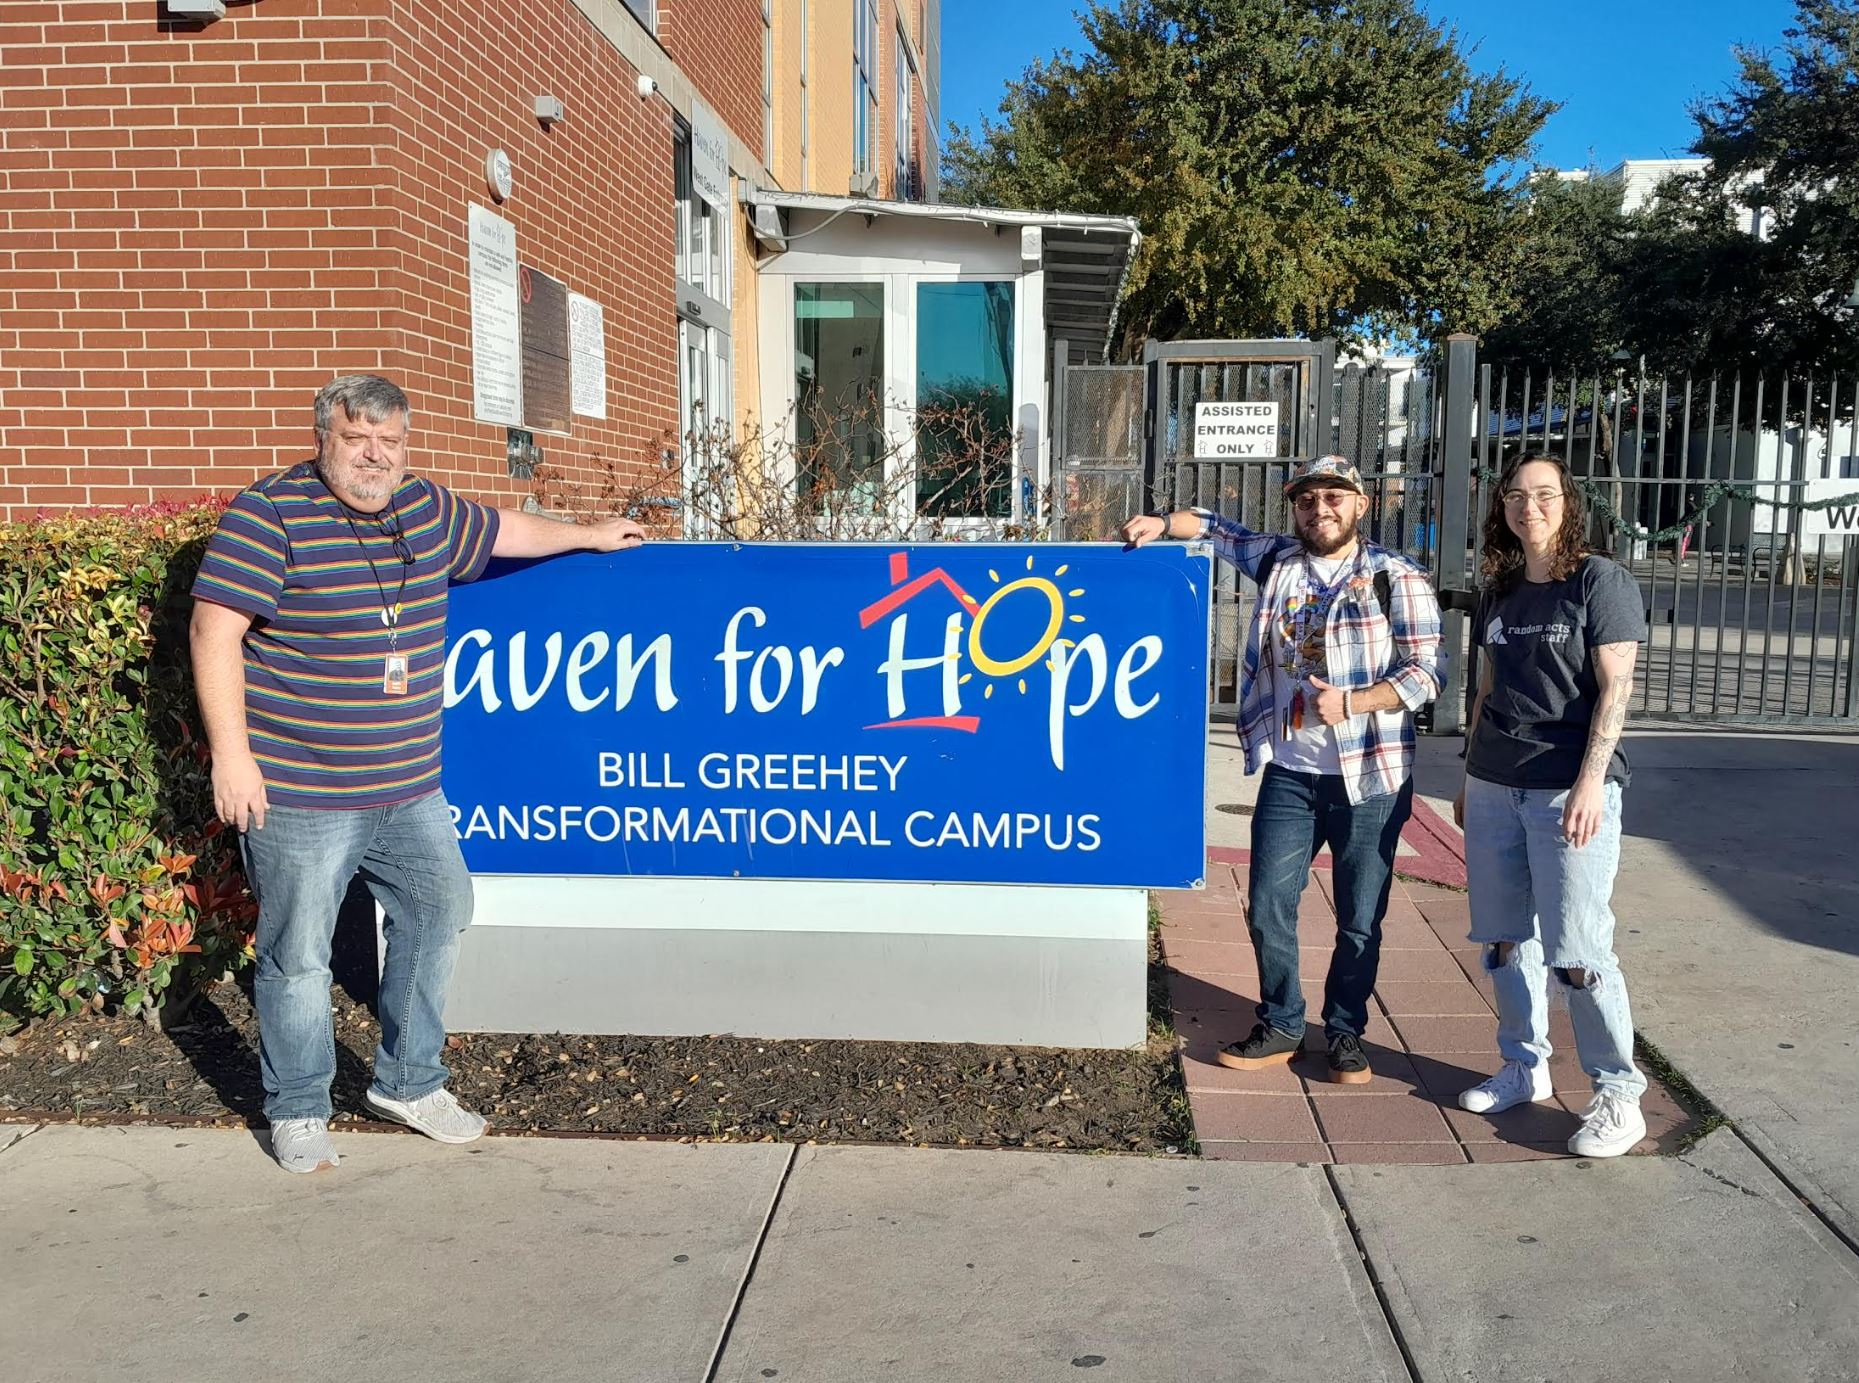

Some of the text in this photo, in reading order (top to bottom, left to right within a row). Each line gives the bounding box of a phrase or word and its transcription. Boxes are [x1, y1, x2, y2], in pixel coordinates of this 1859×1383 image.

[1202, 406, 1272, 416] ASSISTED
[1197, 425, 1275, 435] ENTRANCE
[1216, 444, 1255, 454] ONLY
[1826, 505, 1859, 529] W
[1507, 622, 1571, 635] random acts
[1540, 633, 1569, 644] staff
[443, 628, 678, 713] aven
[714, 606, 845, 716] for
[877, 576, 1163, 771] Hope
[599, 752, 908, 791] BILL GREEHEY
[448, 804, 1101, 851] RANSFORMATIONAL CAMPUS
